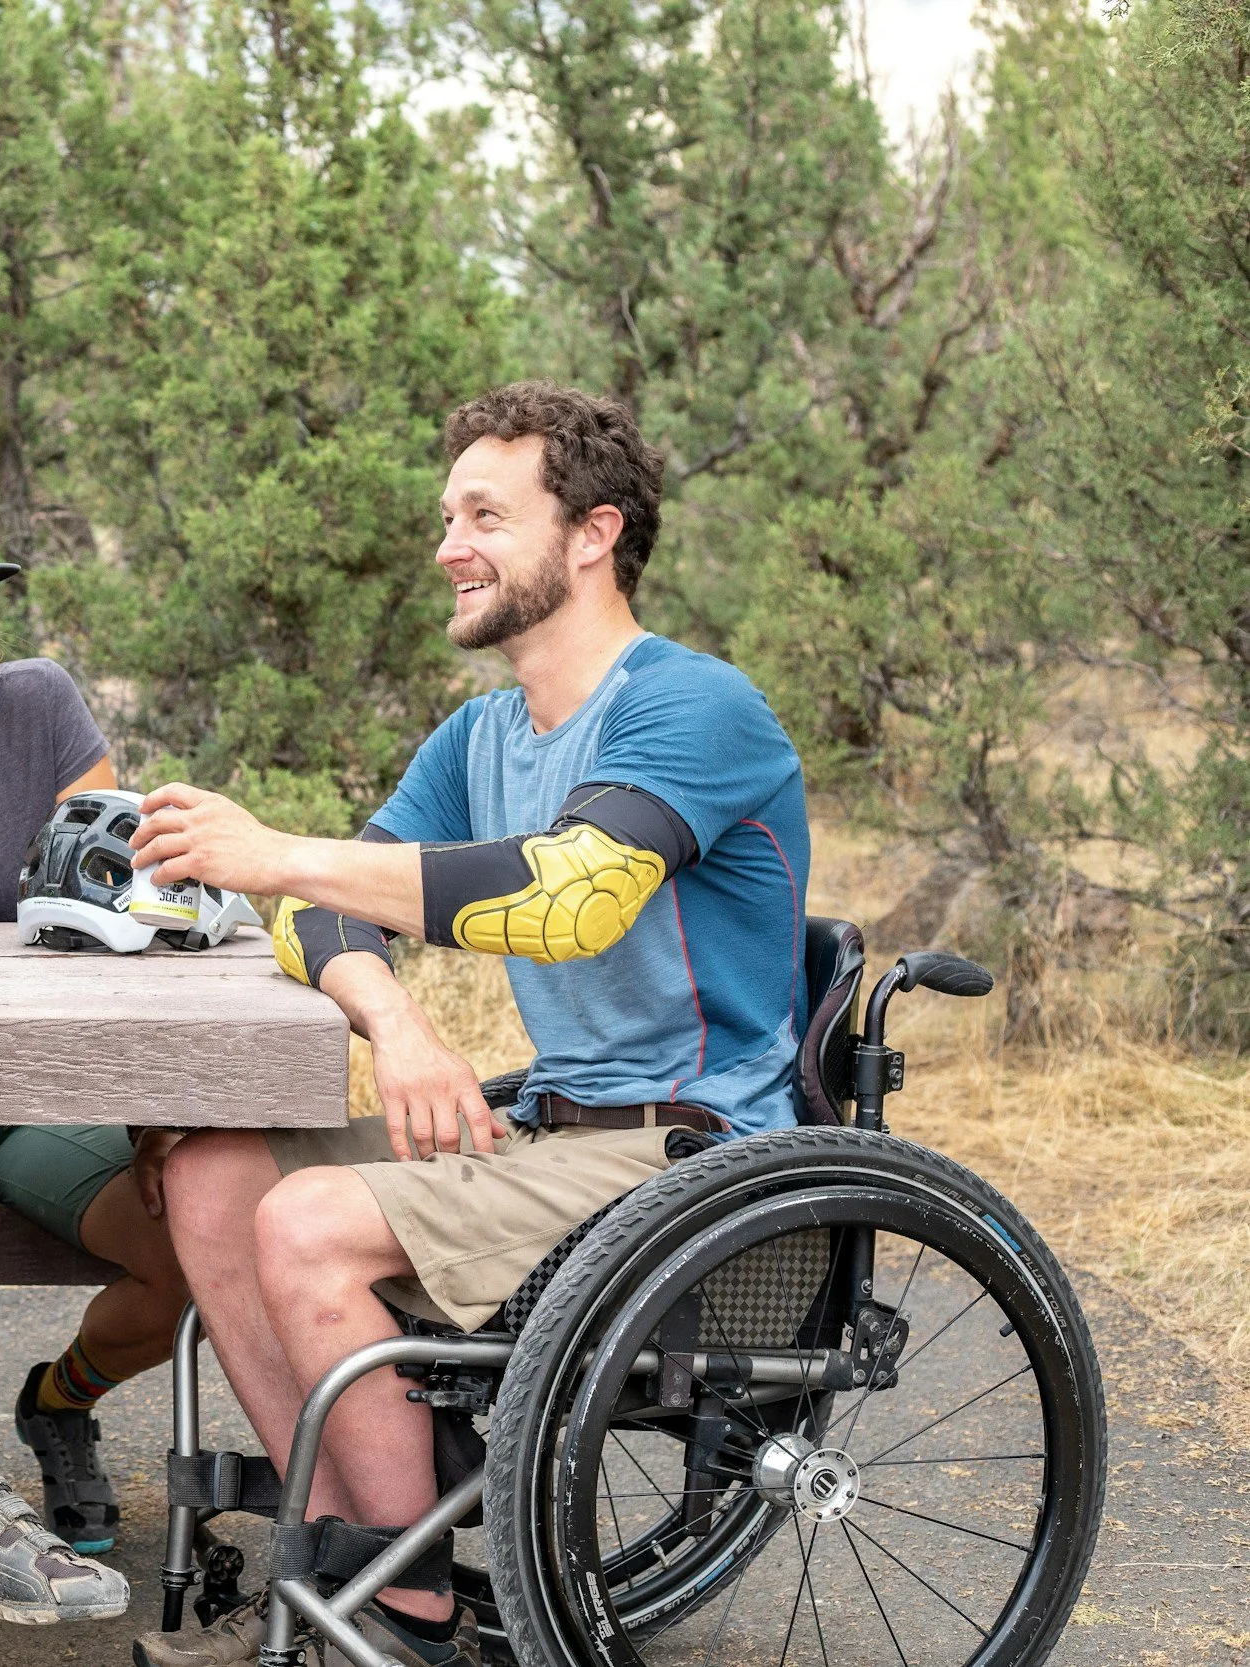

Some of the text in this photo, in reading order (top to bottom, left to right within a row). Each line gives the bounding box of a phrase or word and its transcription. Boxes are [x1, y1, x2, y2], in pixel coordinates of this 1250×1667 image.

[159, 891, 193, 907] JOE IPA
[1019, 1253, 1049, 1288] PLUS
[1046, 1293, 1068, 1329] TOUR
[585, 1571, 616, 1638] SURGE
[663, 1588, 696, 1613] PLUS
[627, 1611, 660, 1630] TOUR
